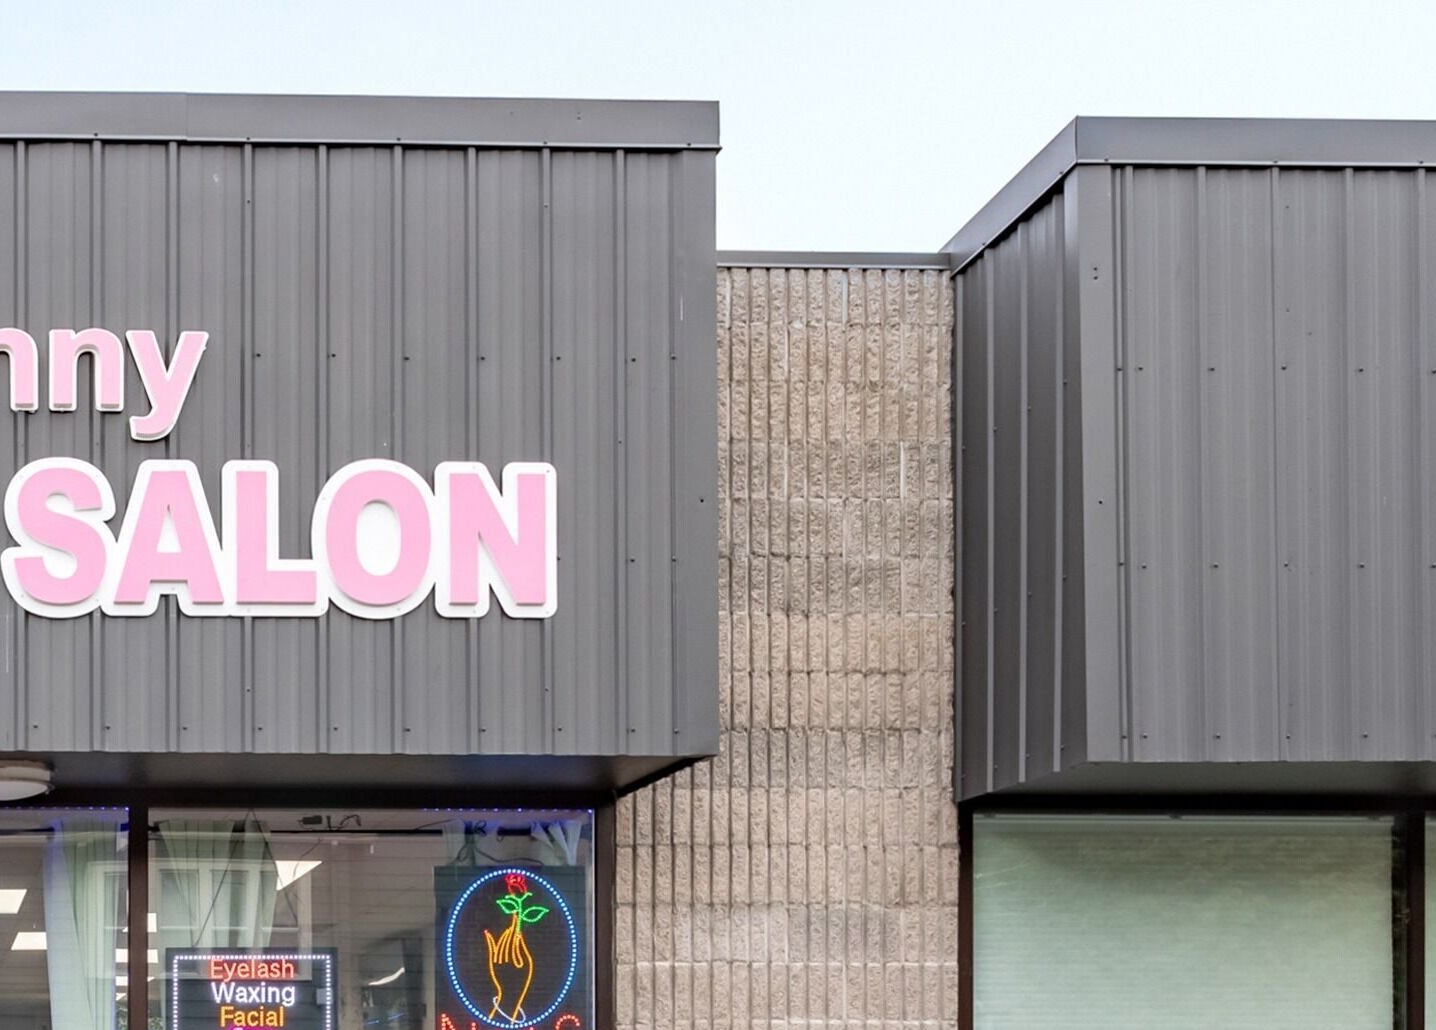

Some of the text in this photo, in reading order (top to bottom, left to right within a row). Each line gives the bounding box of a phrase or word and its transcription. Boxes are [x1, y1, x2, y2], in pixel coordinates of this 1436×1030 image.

[0, 457, 558, 619] SALON
[209, 957, 295, 983] Eyelash
[210, 981, 296, 1007] Waxing
[219, 1005, 285, 1028] Facial
